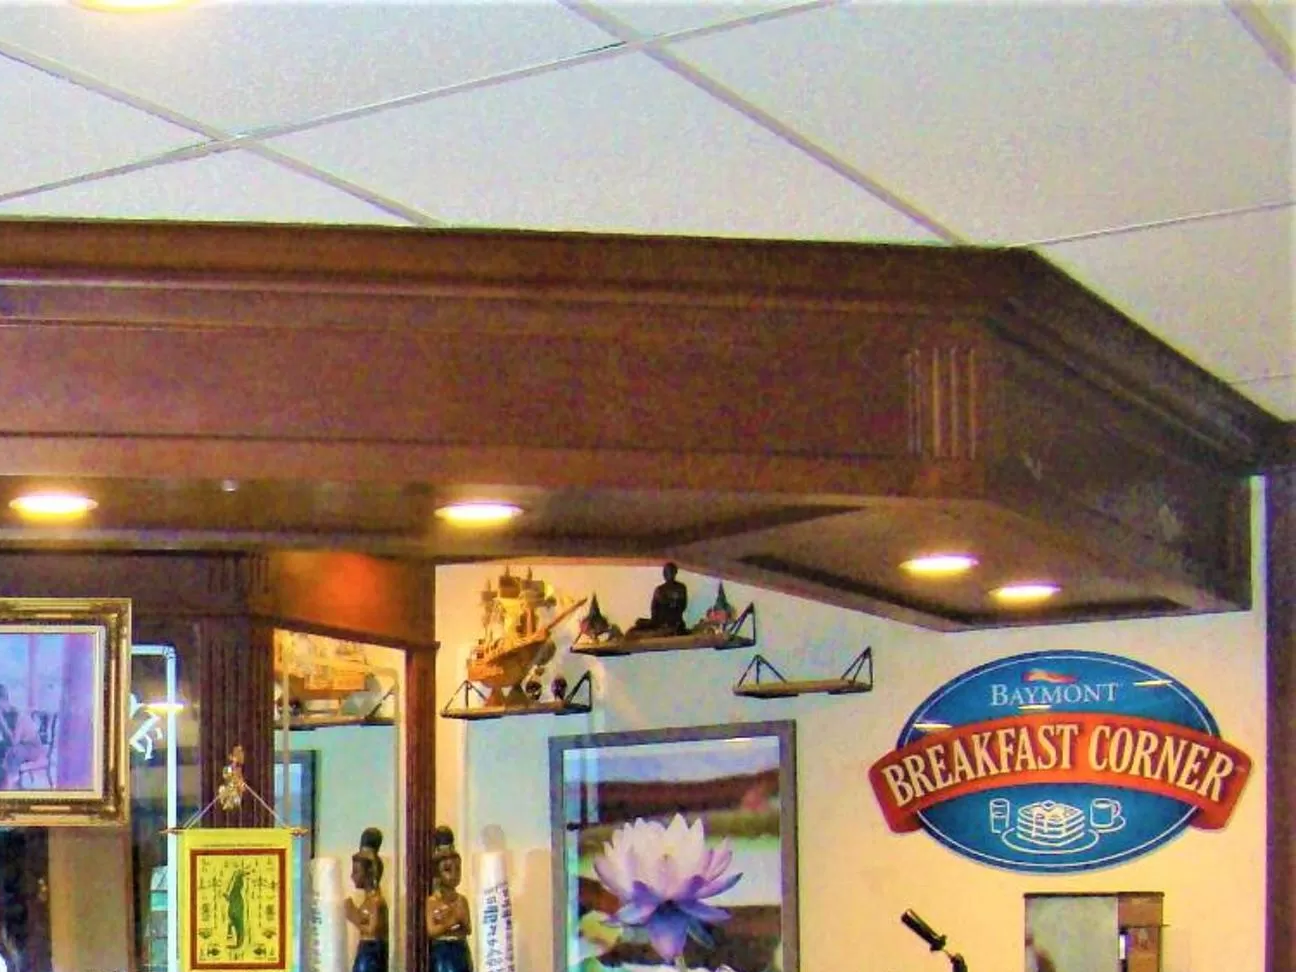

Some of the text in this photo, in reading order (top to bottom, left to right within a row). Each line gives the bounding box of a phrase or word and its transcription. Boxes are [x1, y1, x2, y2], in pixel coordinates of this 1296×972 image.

[990, 682, 1118, 706] BAYMONT
[880, 722, 1235, 808] BREAKFAST CORNER
